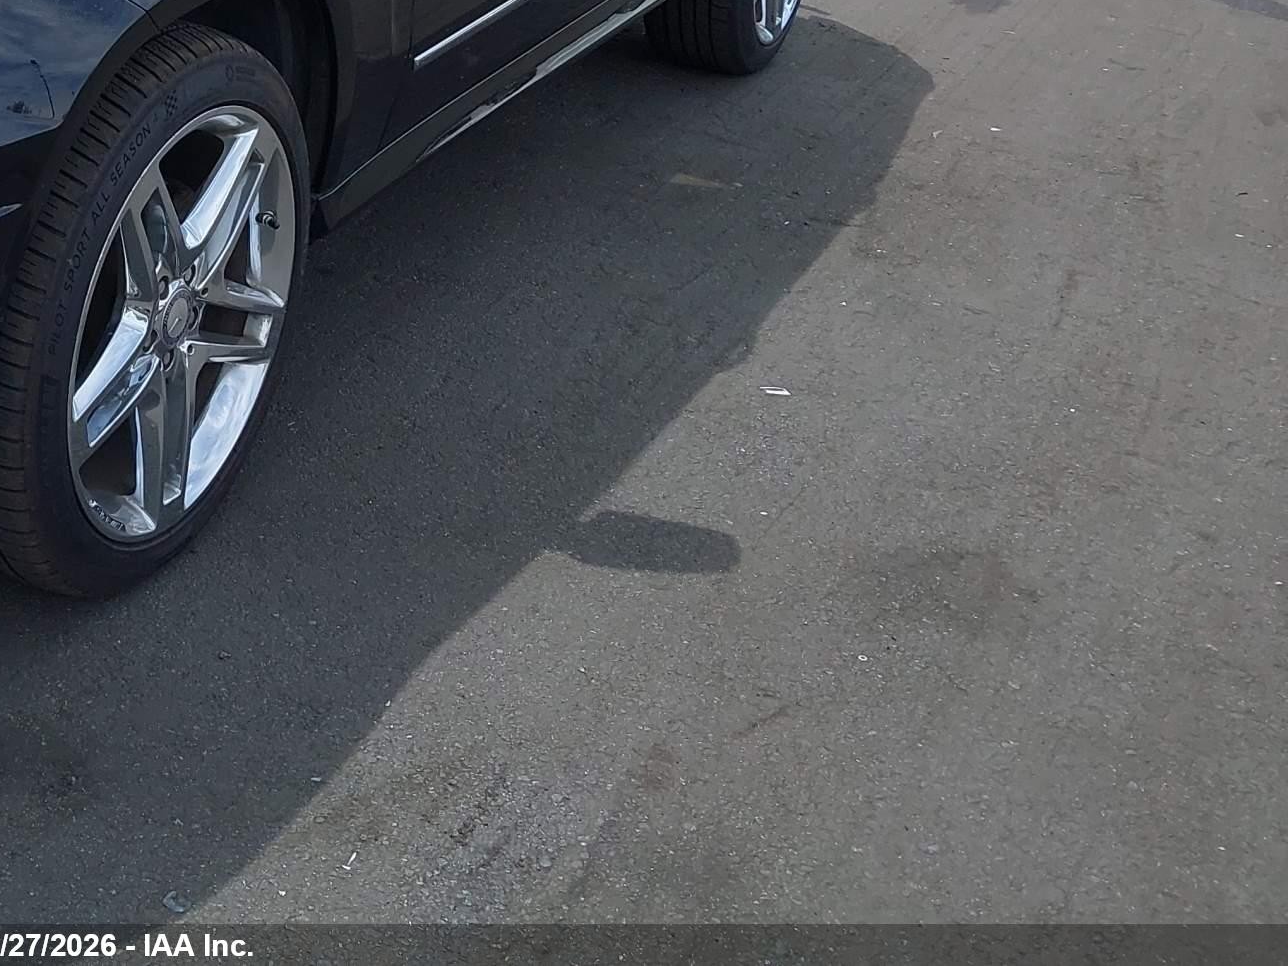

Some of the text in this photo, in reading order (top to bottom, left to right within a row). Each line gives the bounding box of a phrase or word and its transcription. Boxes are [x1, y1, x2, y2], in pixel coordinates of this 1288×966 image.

[64, 226, 92, 292] SPORT
[90, 192, 111, 225] ALL
[110, 122, 152, 186] SEASON
